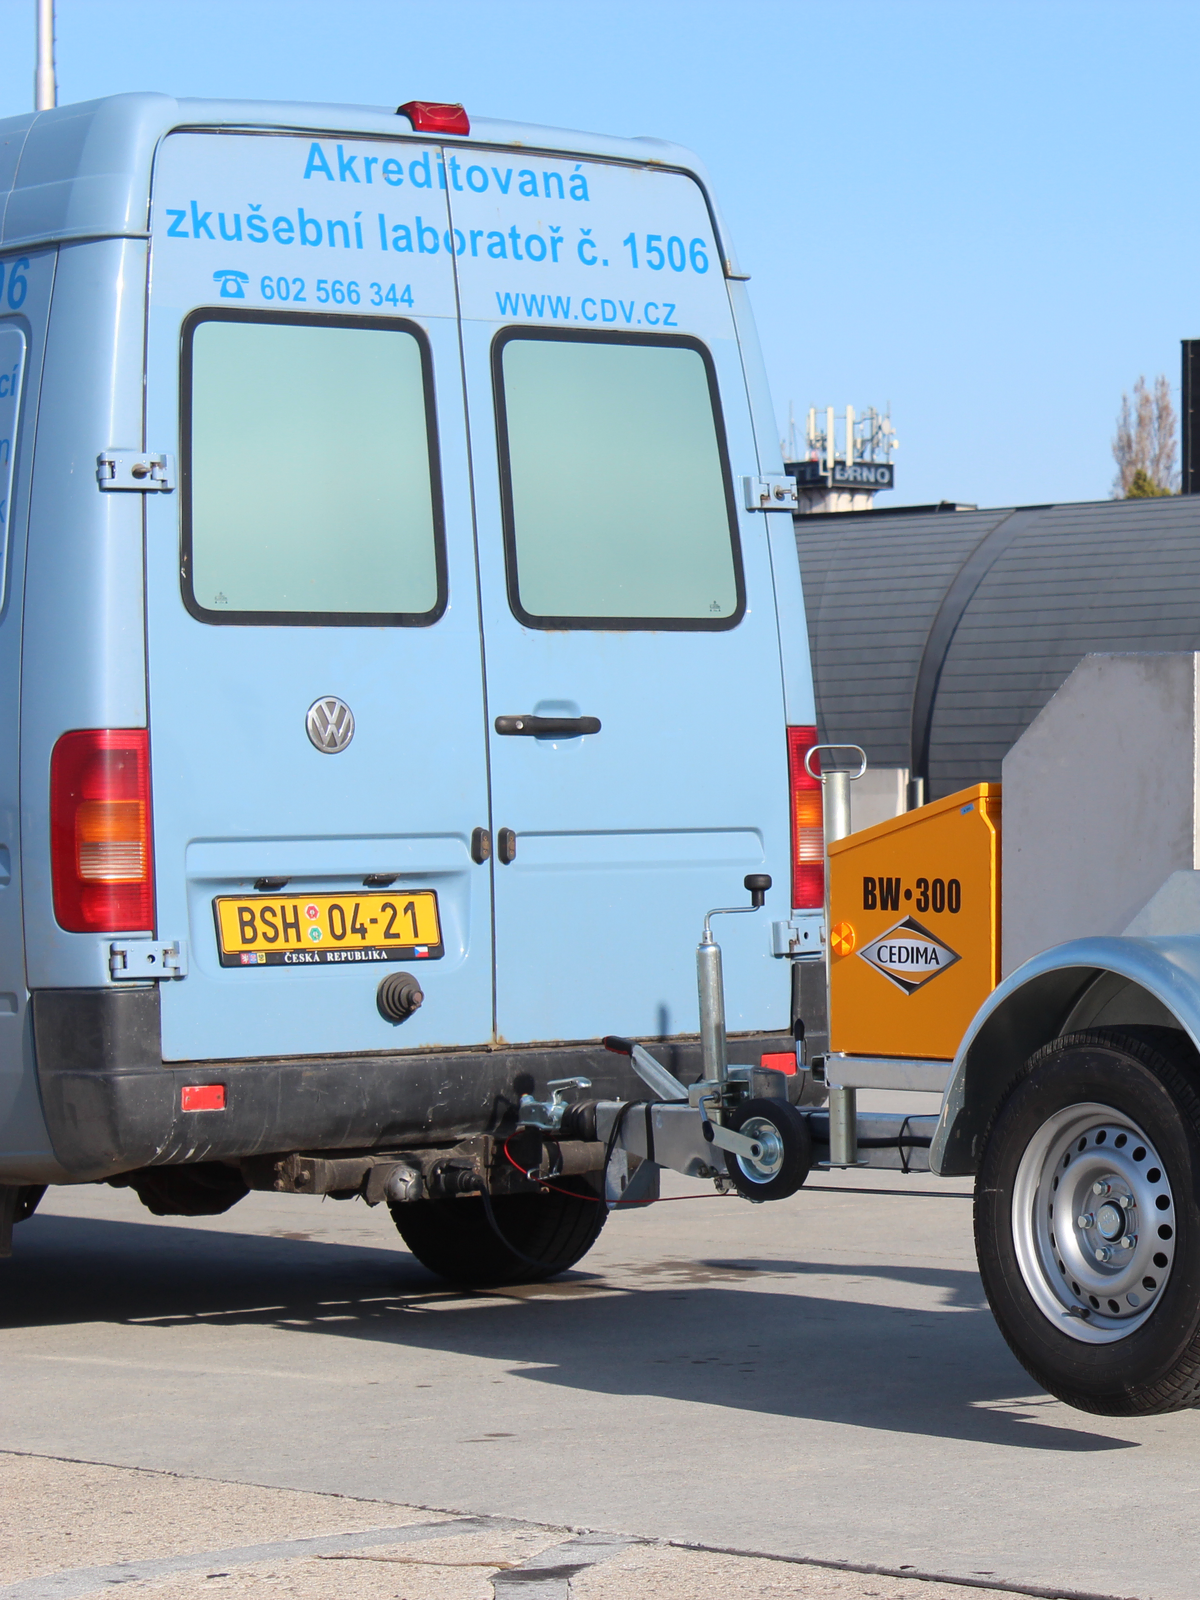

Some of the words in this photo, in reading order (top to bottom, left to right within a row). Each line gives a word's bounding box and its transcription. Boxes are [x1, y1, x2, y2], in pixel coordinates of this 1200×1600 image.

[303, 142, 590, 202] Akreditovaná
[166, 200, 364, 250] zkušební
[378, 213, 564, 263] laboratoř
[577, 228, 609, 267] č.
[623, 232, 709, 274] 1506
[0, 257, 30, 309] 6
[260, 276, 307, 302] 602
[316, 279, 361, 305] 566
[369, 282, 414, 308] 344
[835, 464, 890, 483] BRNO
[306, 695, 355, 754] VW
[237, 905, 302, 944] BSH
[328, 901, 419, 942] 04-21
[284, 951, 320, 963] ČESKÁ
[327, 950, 388, 962] REPUBLIKA
[877, 945, 940, 965] CEDIMA
